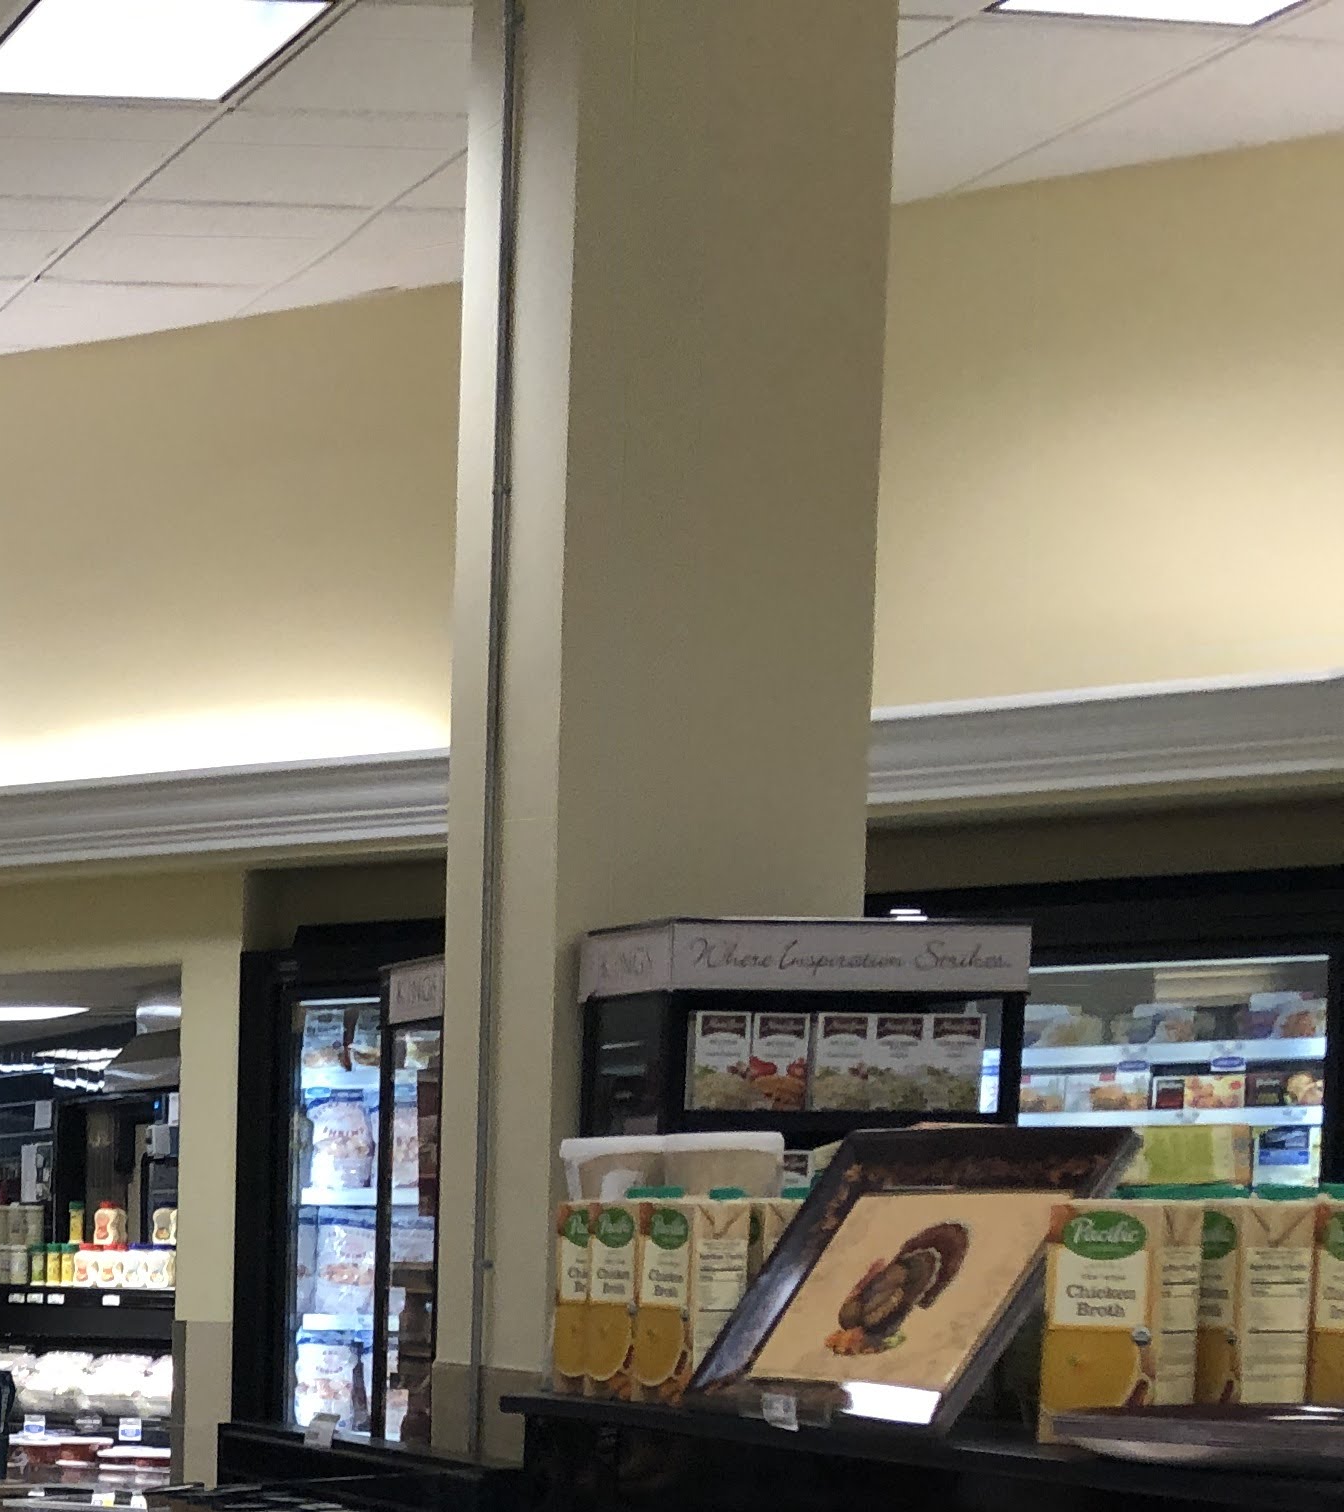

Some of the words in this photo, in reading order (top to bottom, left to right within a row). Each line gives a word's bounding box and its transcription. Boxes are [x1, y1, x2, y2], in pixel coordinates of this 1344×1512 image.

[1070, 1217, 1139, 1243] Pacific
[1066, 1284, 1136, 1300] Chicken
[1077, 1302, 1125, 1317] Broth
